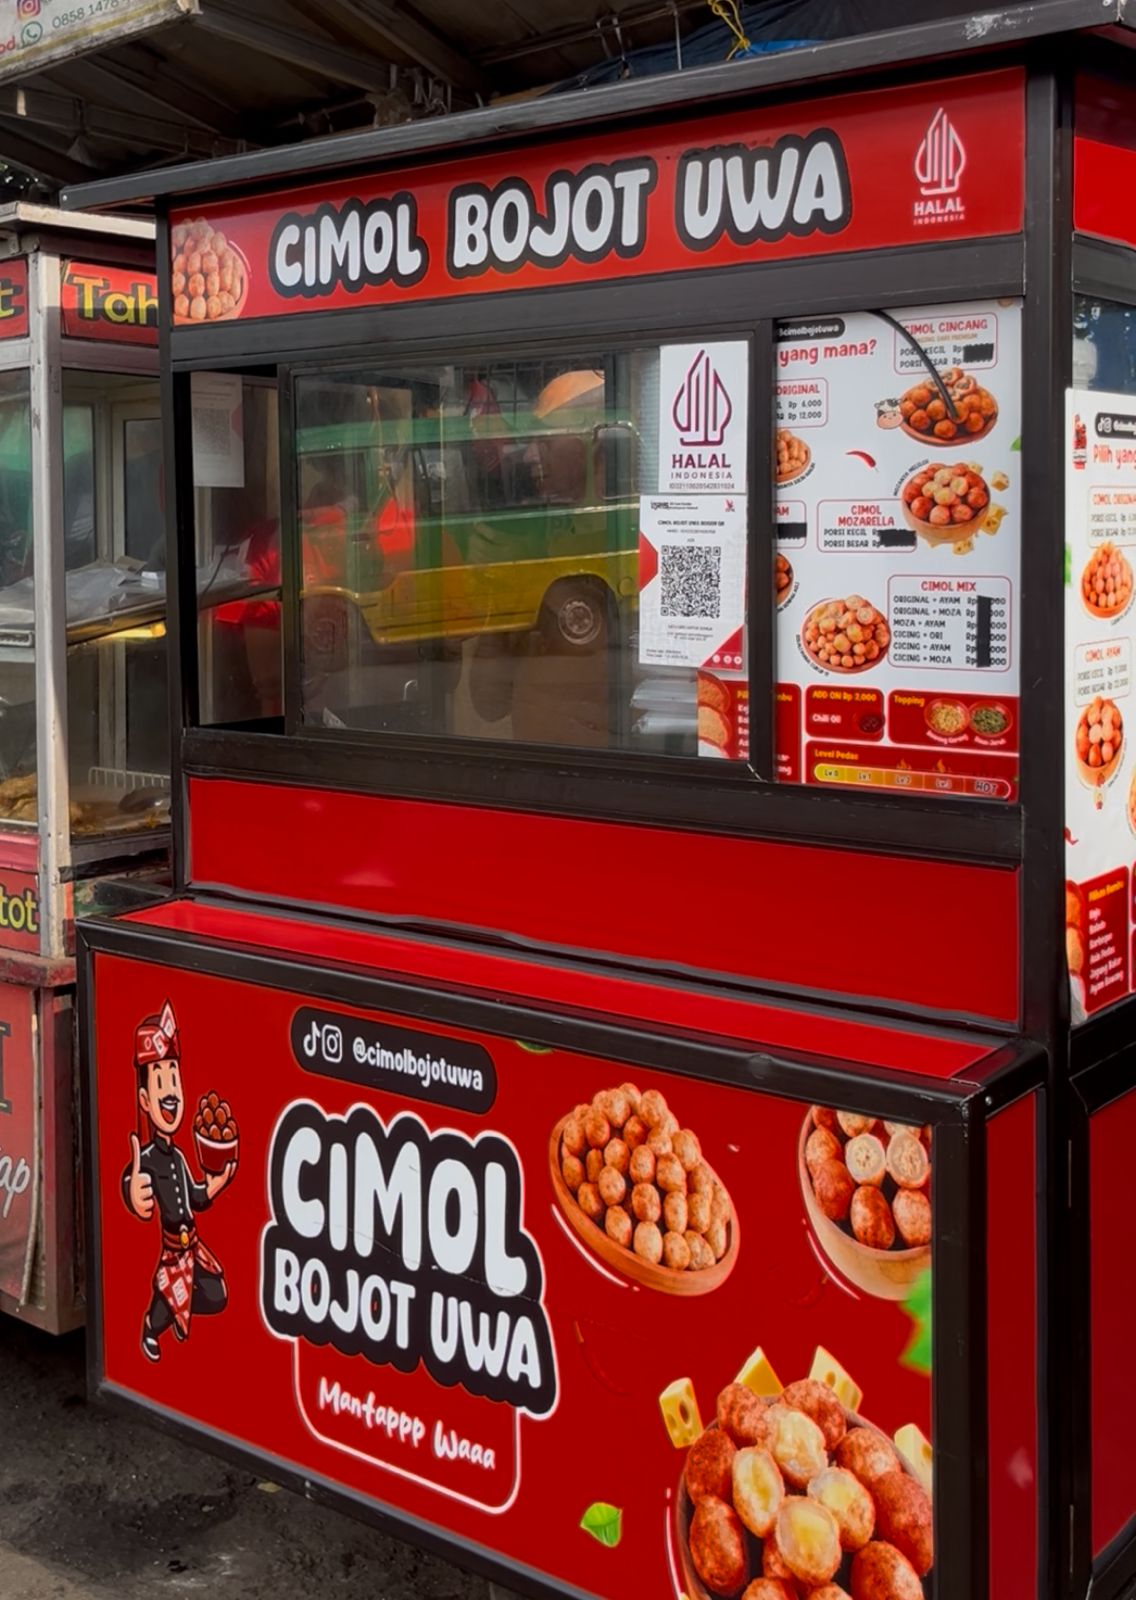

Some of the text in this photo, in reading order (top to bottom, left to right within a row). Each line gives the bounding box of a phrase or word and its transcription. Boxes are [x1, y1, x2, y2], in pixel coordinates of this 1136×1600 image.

[52, 7, 85, 29] 0858
[914, 196, 965, 216] HALAL
[275, 140, 844, 288] CIMOL BOJOT UWA
[913, 213, 965, 225] INDONESIA
[939, 319, 988, 332] CINCANG
[780, 339, 877, 367] yang mana?
[777, 384, 820, 396] ORIGINAL
[672, 453, 731, 468] HALAL
[851, 505, 882, 515] CIMOL
[838, 516, 894, 526] MOZARELLA
[824, 528, 845, 536] PORSI
[847, 528, 867, 536] KECIL
[824, 540, 845, 548] PORSI
[847, 540, 869, 548] BESAR
[921, 581, 976, 592] CIMOL MIX
[893, 595, 930, 604] ORIGINAL
[939, 596, 961, 604] AYAM
[893, 607, 930, 616] ORIGINAL
[938, 608, 961, 616] MOZA
[966, 609, 975, 618] Rp
[893, 619, 915, 627] MOZA
[924, 619, 946, 627] AYAM
[893, 631, 921, 639] CICING
[929, 631, 943, 639] ORI
[893, 642, 921, 650] CICING
[929, 643, 951, 651] AYAM
[893, 654, 921, 662] CICING
[929, 655, 952, 663] MOZA
[812, 690, 828, 699] ADD
[894, 695, 925, 707] Topping
[814, 749, 859, 760] Level Pedas
[352, 1036, 483, 1091] @cimolbojotuwa
[282, 1126, 527, 1297] CIMOL
[274, 1247, 541, 1388] BOJOT UWA
[319, 1376, 496, 1469] Mantappp Waaa
